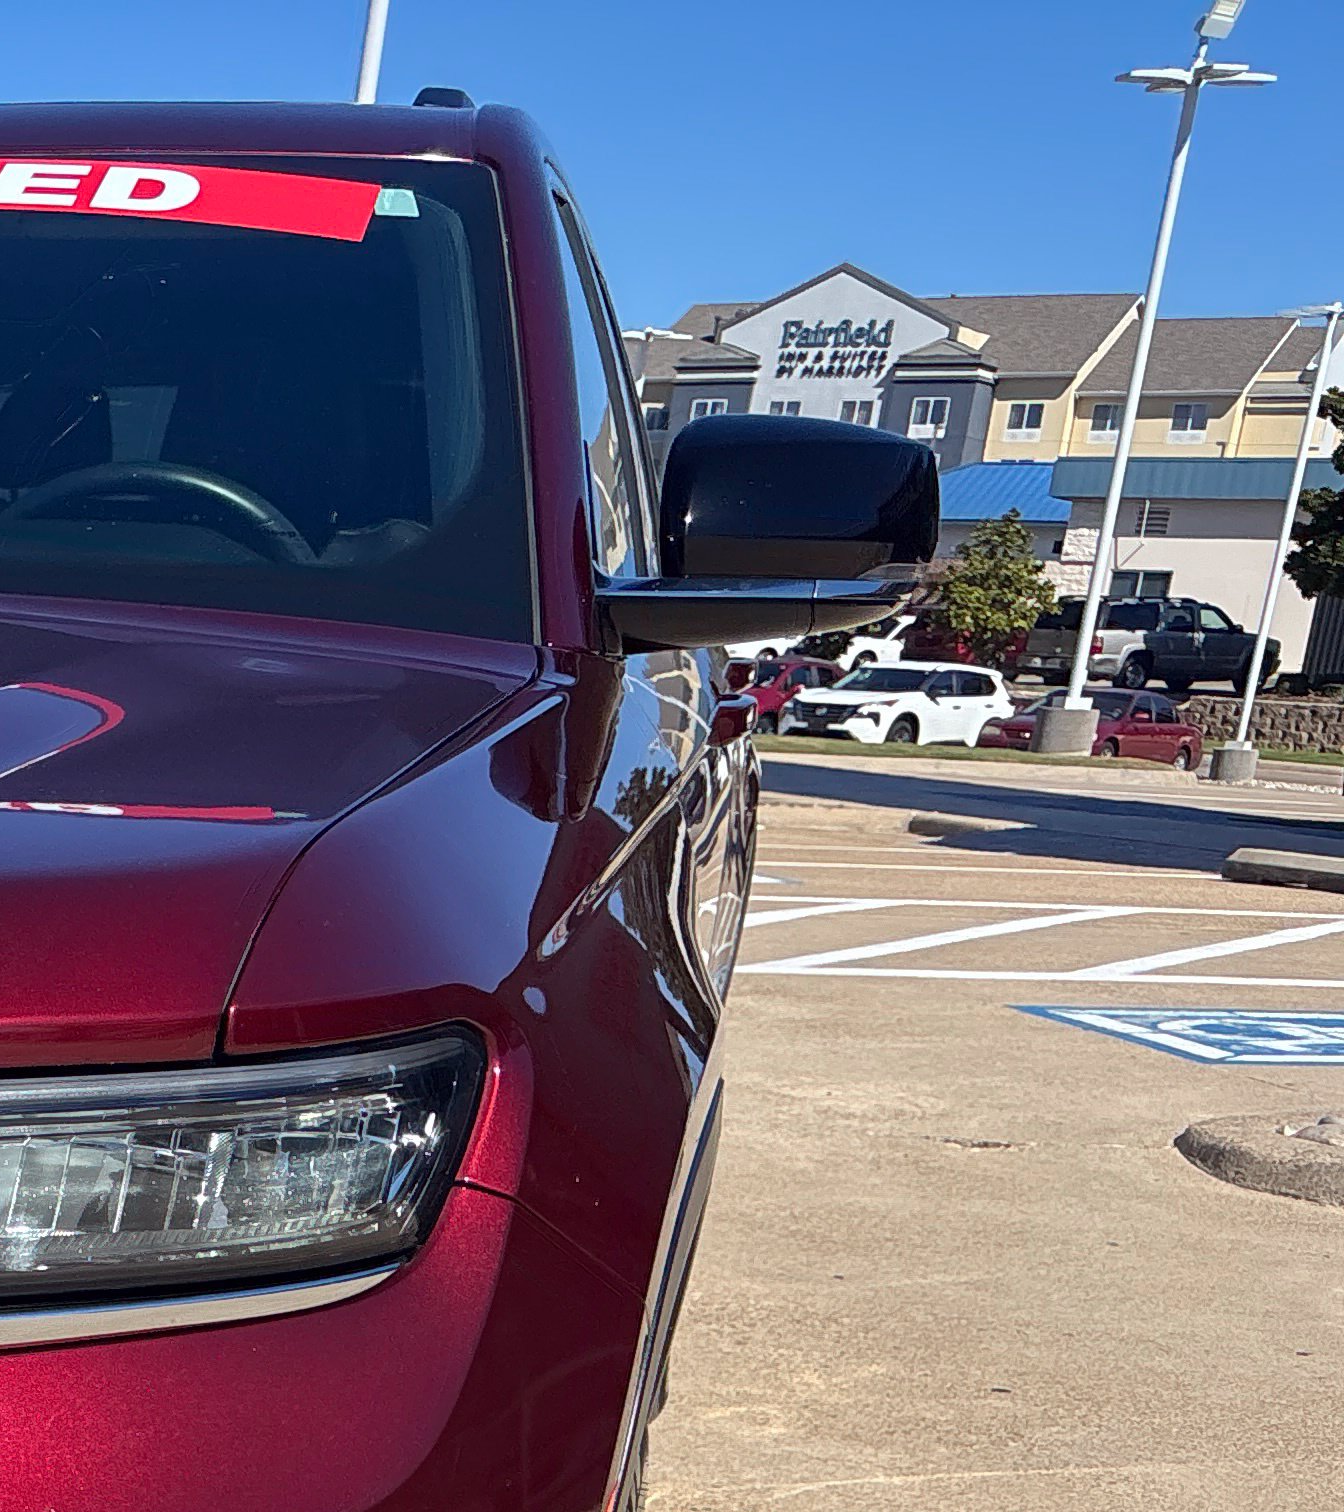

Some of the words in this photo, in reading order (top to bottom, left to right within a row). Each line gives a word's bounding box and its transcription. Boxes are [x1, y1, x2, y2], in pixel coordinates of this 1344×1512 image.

[778, 318, 895, 349] Fairfield
[778, 350, 809, 364] INN
[830, 350, 889, 365] SUITES
[775, 364, 798, 378] BY
[800, 364, 886, 379] MARRIOTT
